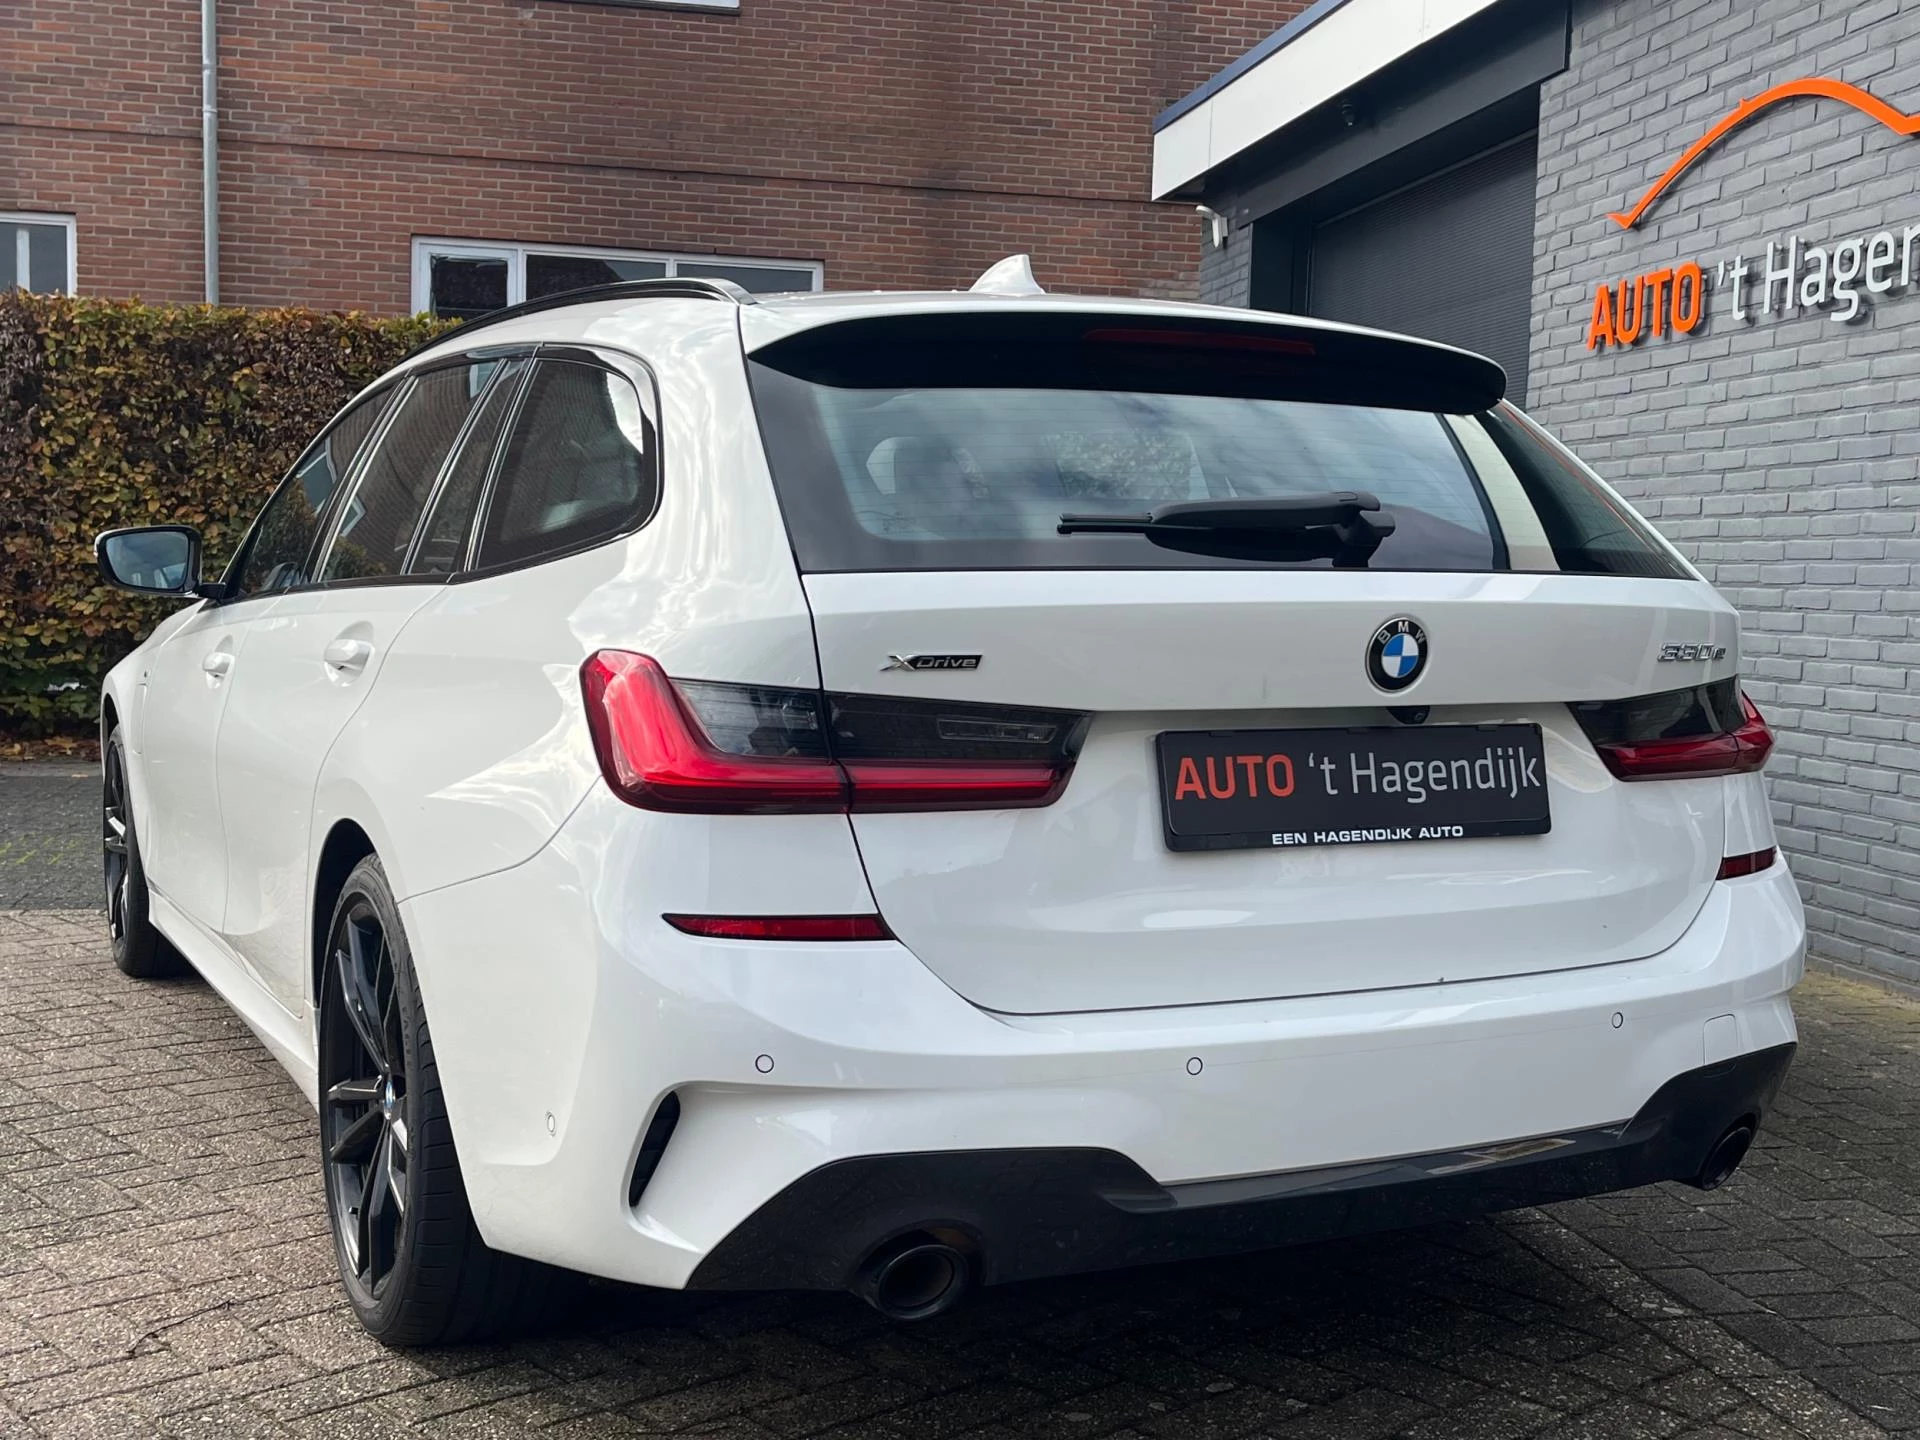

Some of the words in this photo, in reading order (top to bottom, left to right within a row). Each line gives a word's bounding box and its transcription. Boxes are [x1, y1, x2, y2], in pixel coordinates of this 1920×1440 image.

[1586, 260, 1702, 350] AUTO
[1377, 620, 1426, 644] BMW
[1175, 753, 1296, 801] AUTO
[1350, 746, 1541, 804] Hagendijk
[1272, 832, 1307, 846] EEN
[1314, 828, 1412, 844] HAGENDIJK
[1419, 825, 1464, 839] AUTO
